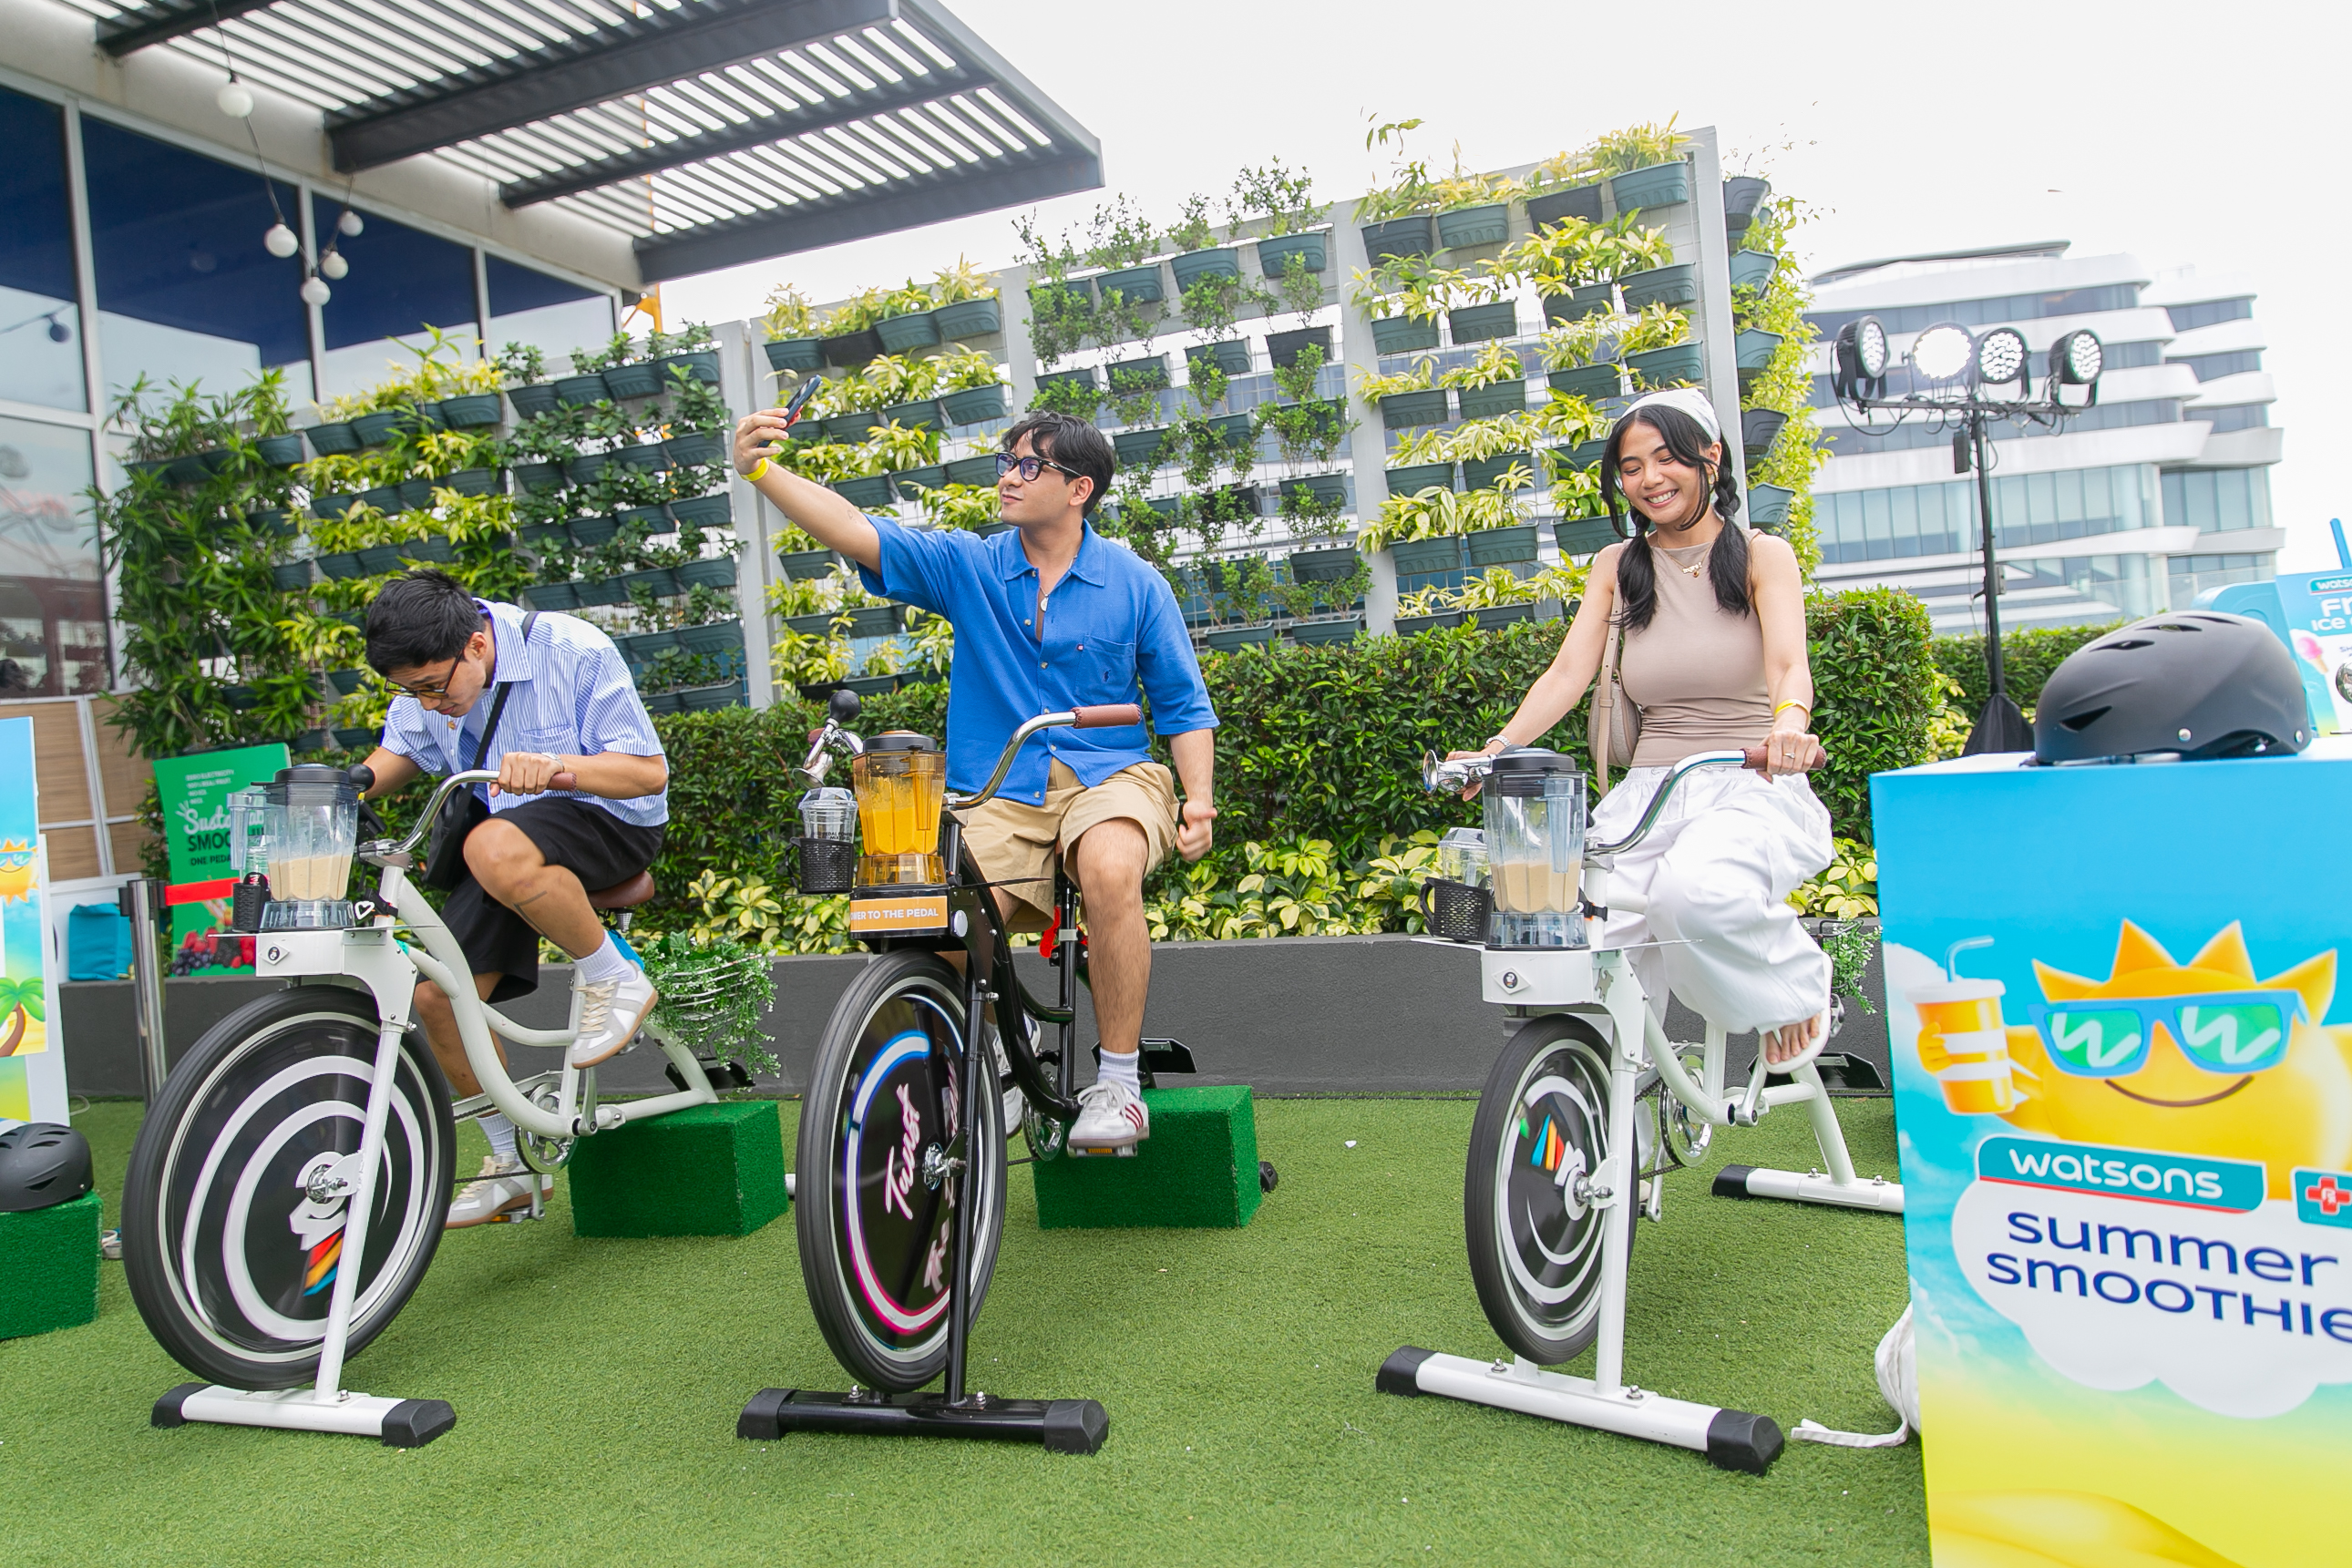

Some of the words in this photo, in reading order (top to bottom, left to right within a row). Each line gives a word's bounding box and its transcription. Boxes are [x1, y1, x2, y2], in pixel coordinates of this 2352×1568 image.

[2316, 579, 2352, 589] wats
[868, 910, 881, 920] TO
[882, 909, 905, 918] THE
[906, 907, 939, 917] PEDAL
[2008, 1148, 2224, 1199] watsons
[2007, 1211, 2339, 1287] summer
